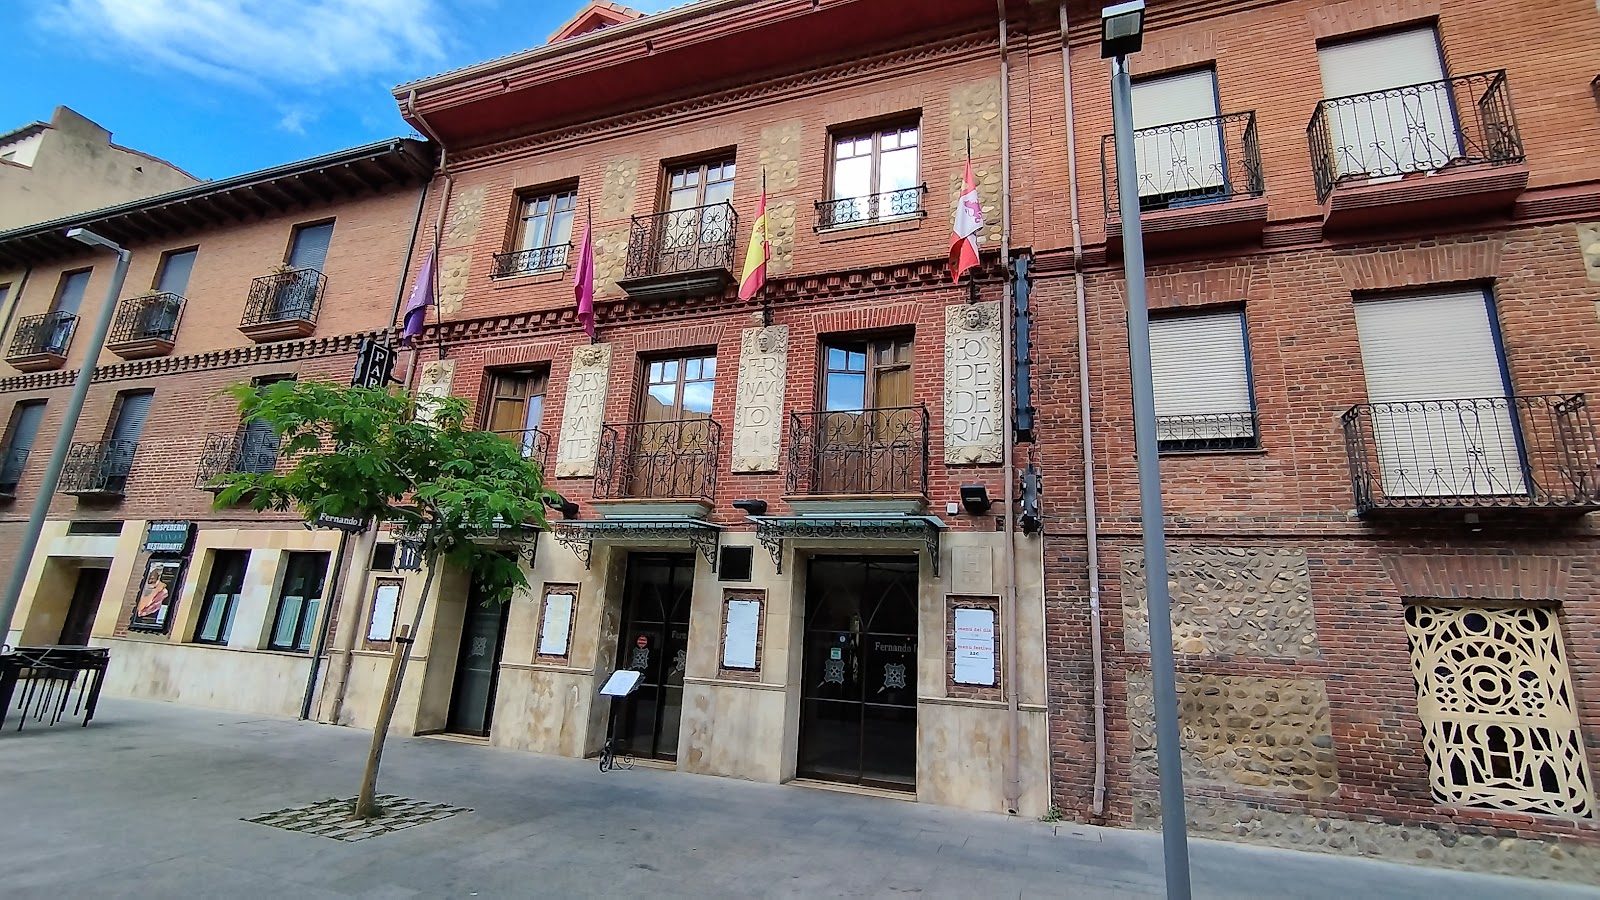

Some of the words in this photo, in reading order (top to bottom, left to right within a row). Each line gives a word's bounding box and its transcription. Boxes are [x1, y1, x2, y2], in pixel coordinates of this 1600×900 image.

[954, 335, 991, 361] HOS
[572, 372, 600, 393] RES
[954, 362, 991, 388] PE
[954, 389, 991, 415] DE
[566, 438, 591, 460] TE
[319, 512, 358, 526] Fernando
[874, 641, 912, 653] Fernando
